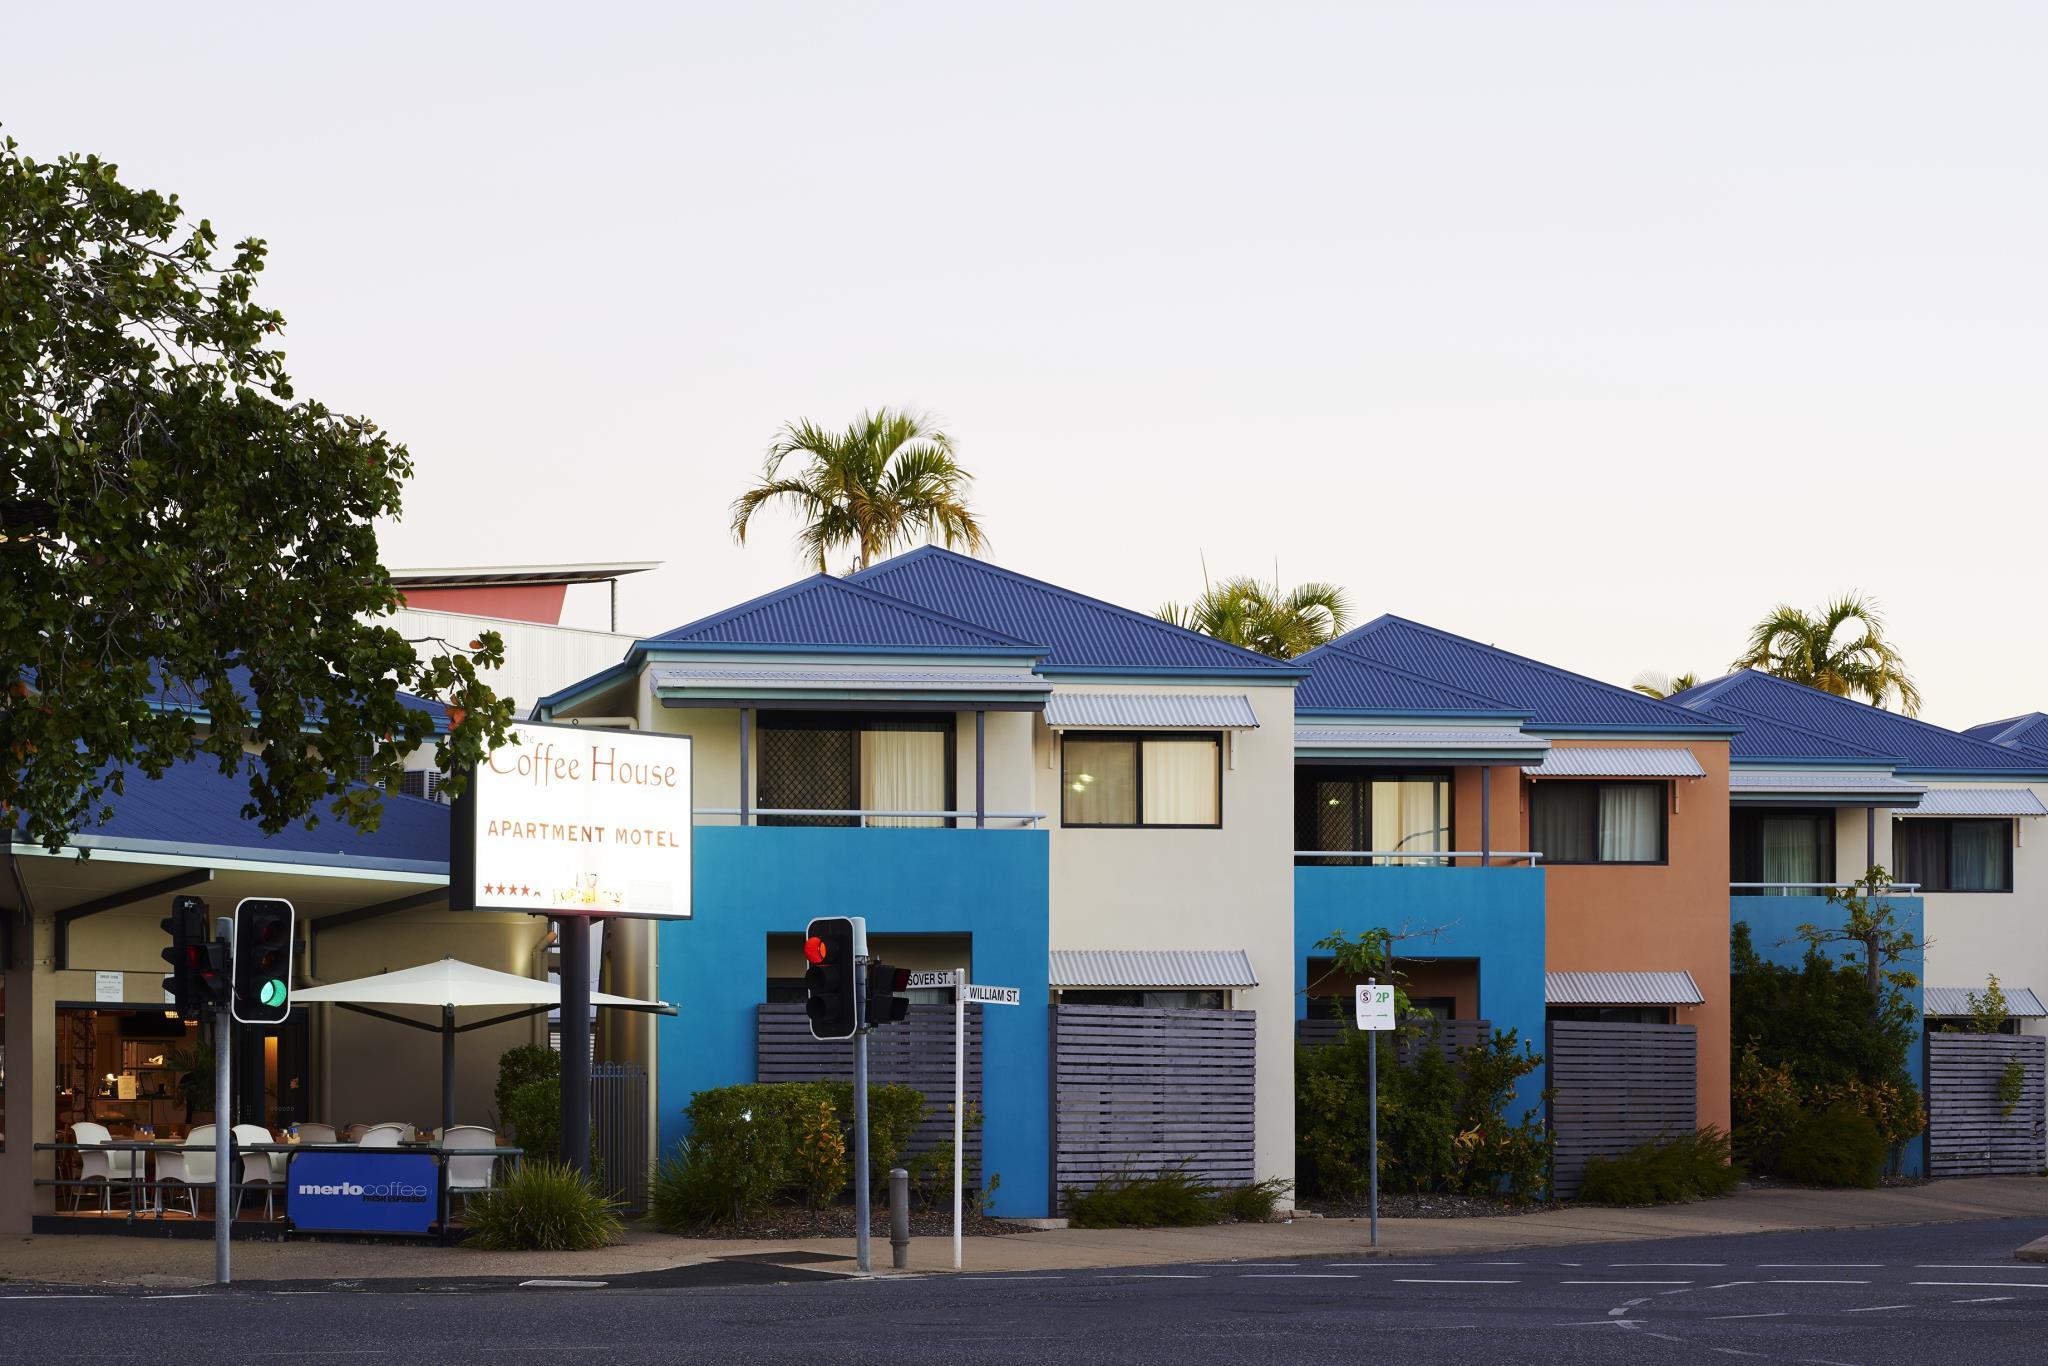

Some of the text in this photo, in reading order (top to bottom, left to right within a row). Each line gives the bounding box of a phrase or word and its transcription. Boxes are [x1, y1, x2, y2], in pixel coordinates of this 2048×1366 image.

[488, 742, 677, 788] Coffee House
[488, 820, 679, 848] APARTMENT MOTEL
[908, 972, 951, 986] SOVER ST.
[969, 987, 1019, 1003] WILLIAM ST.
[1376, 992, 1389, 1002] 2P
